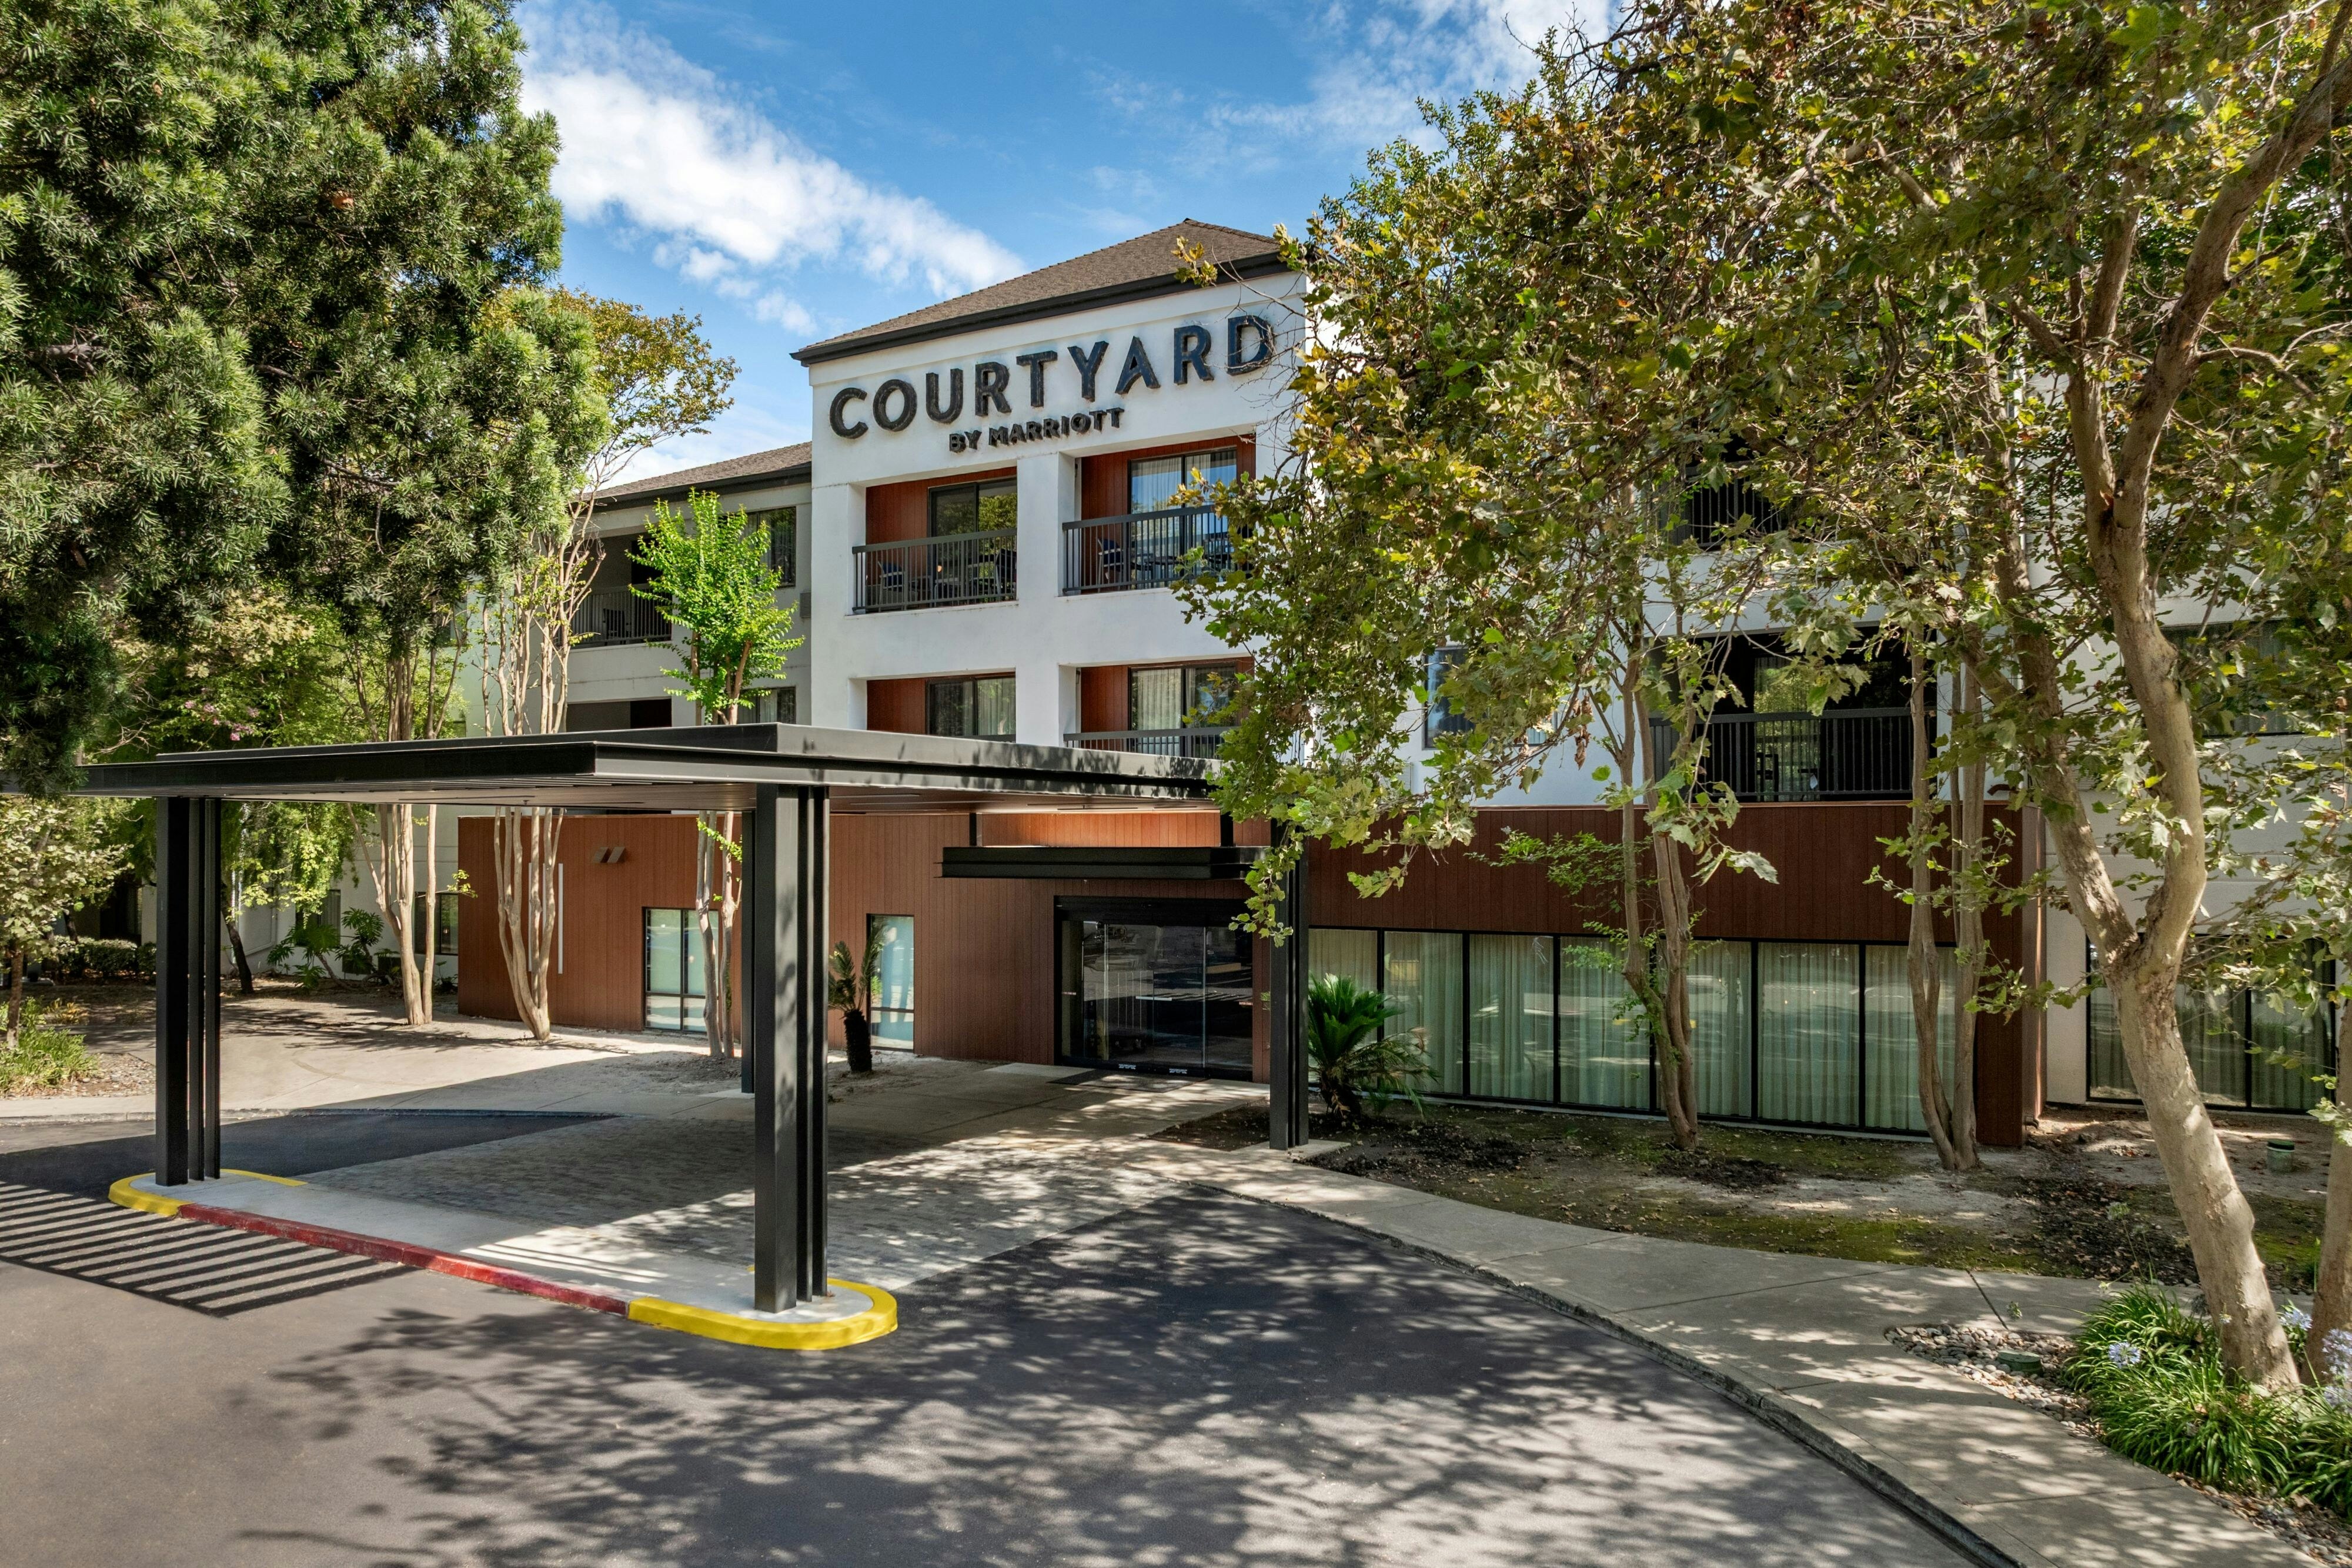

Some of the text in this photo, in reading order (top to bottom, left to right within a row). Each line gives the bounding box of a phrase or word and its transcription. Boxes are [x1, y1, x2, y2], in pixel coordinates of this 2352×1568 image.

[830, 315, 1275, 439] COURTYARD
[949, 407, 1125, 453] BY MARRIOTT
